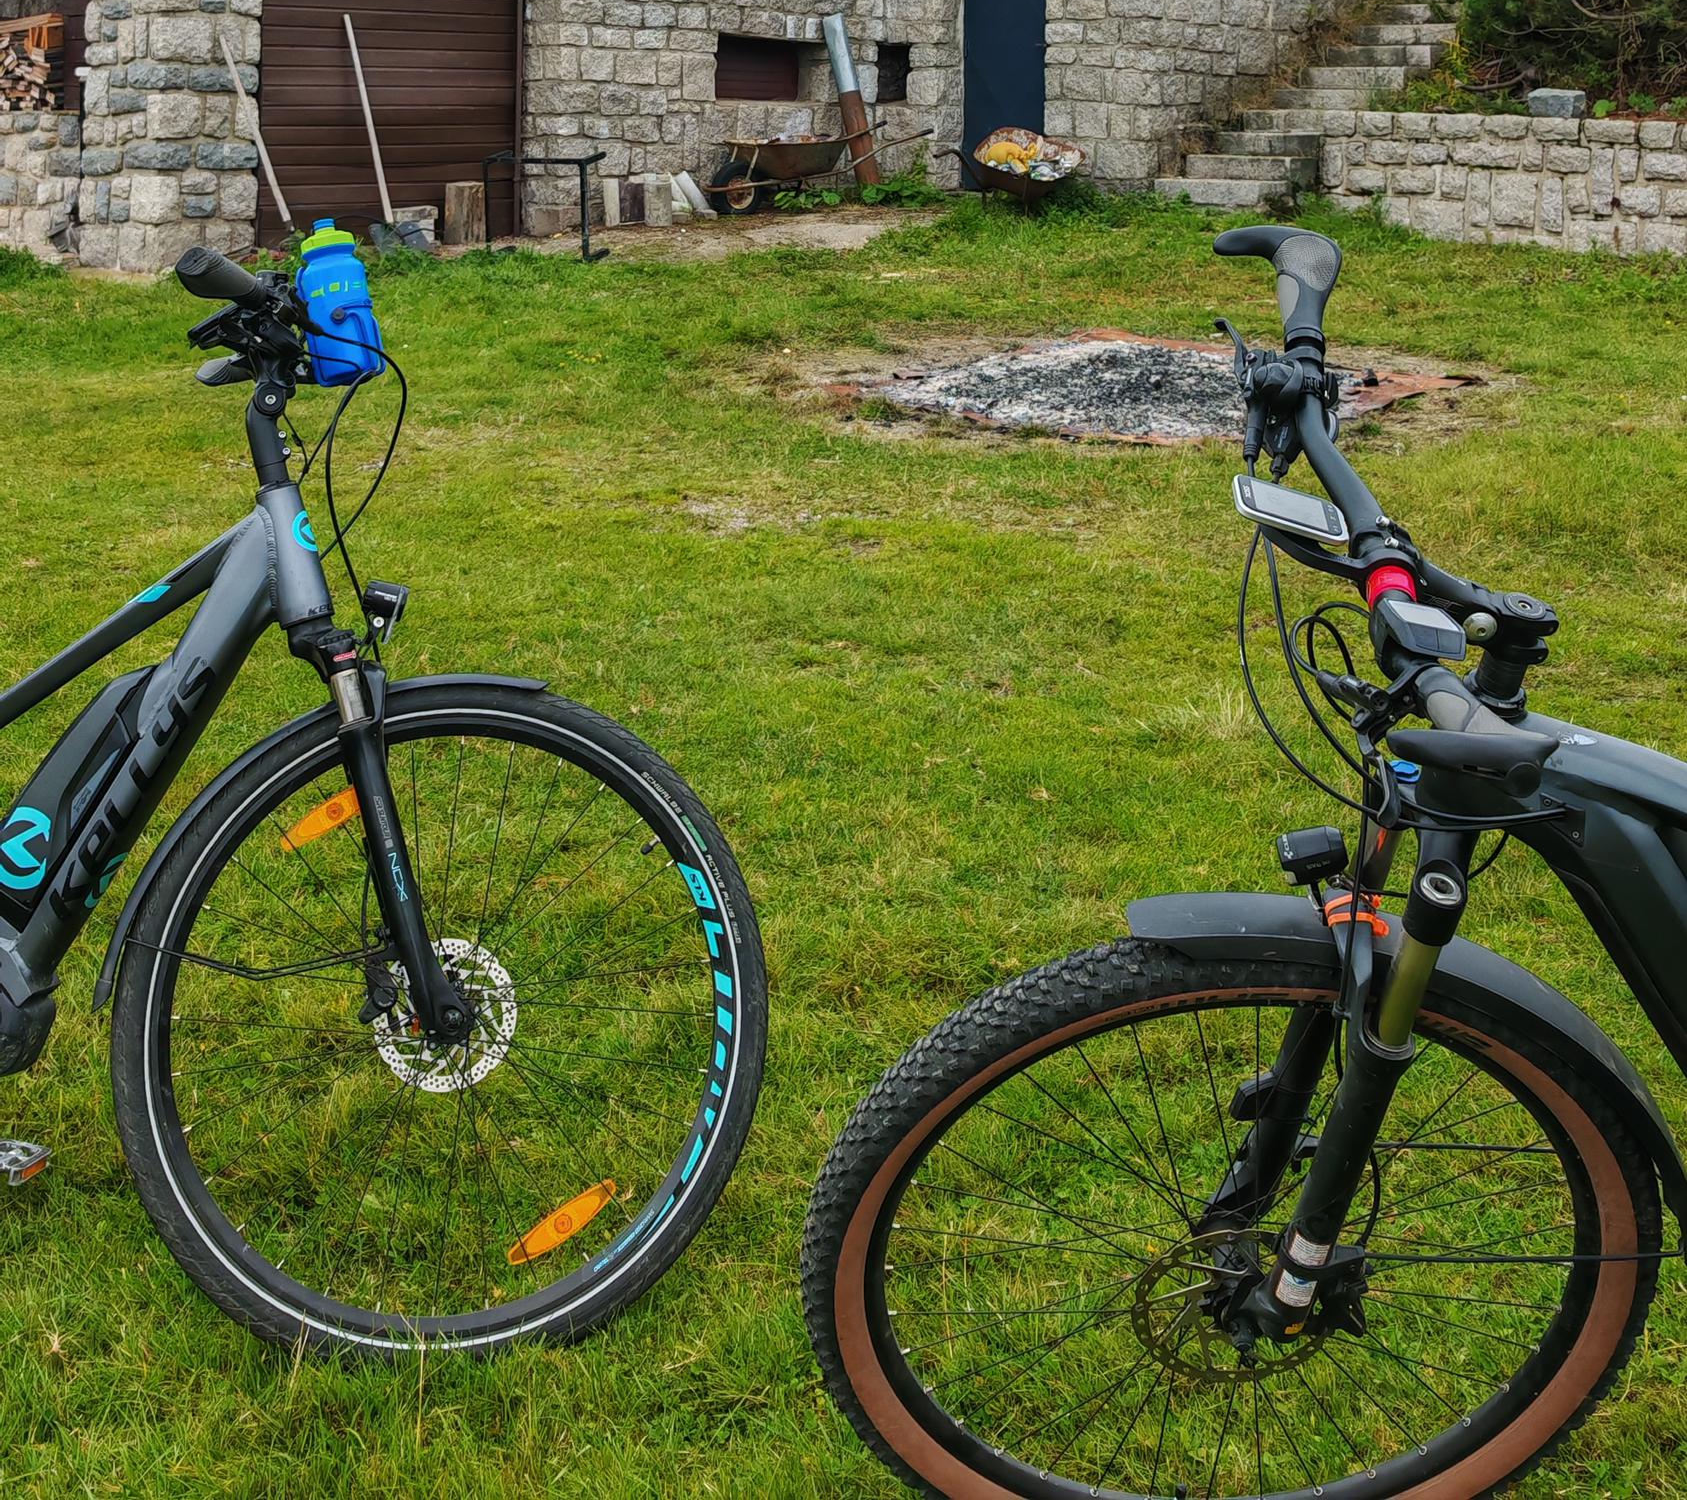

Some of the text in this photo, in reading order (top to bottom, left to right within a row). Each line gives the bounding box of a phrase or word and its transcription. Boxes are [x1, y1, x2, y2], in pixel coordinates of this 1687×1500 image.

[640, 771, 683, 815] SCHWALBE
[705, 853, 736, 919] ACTIVE PLUS
